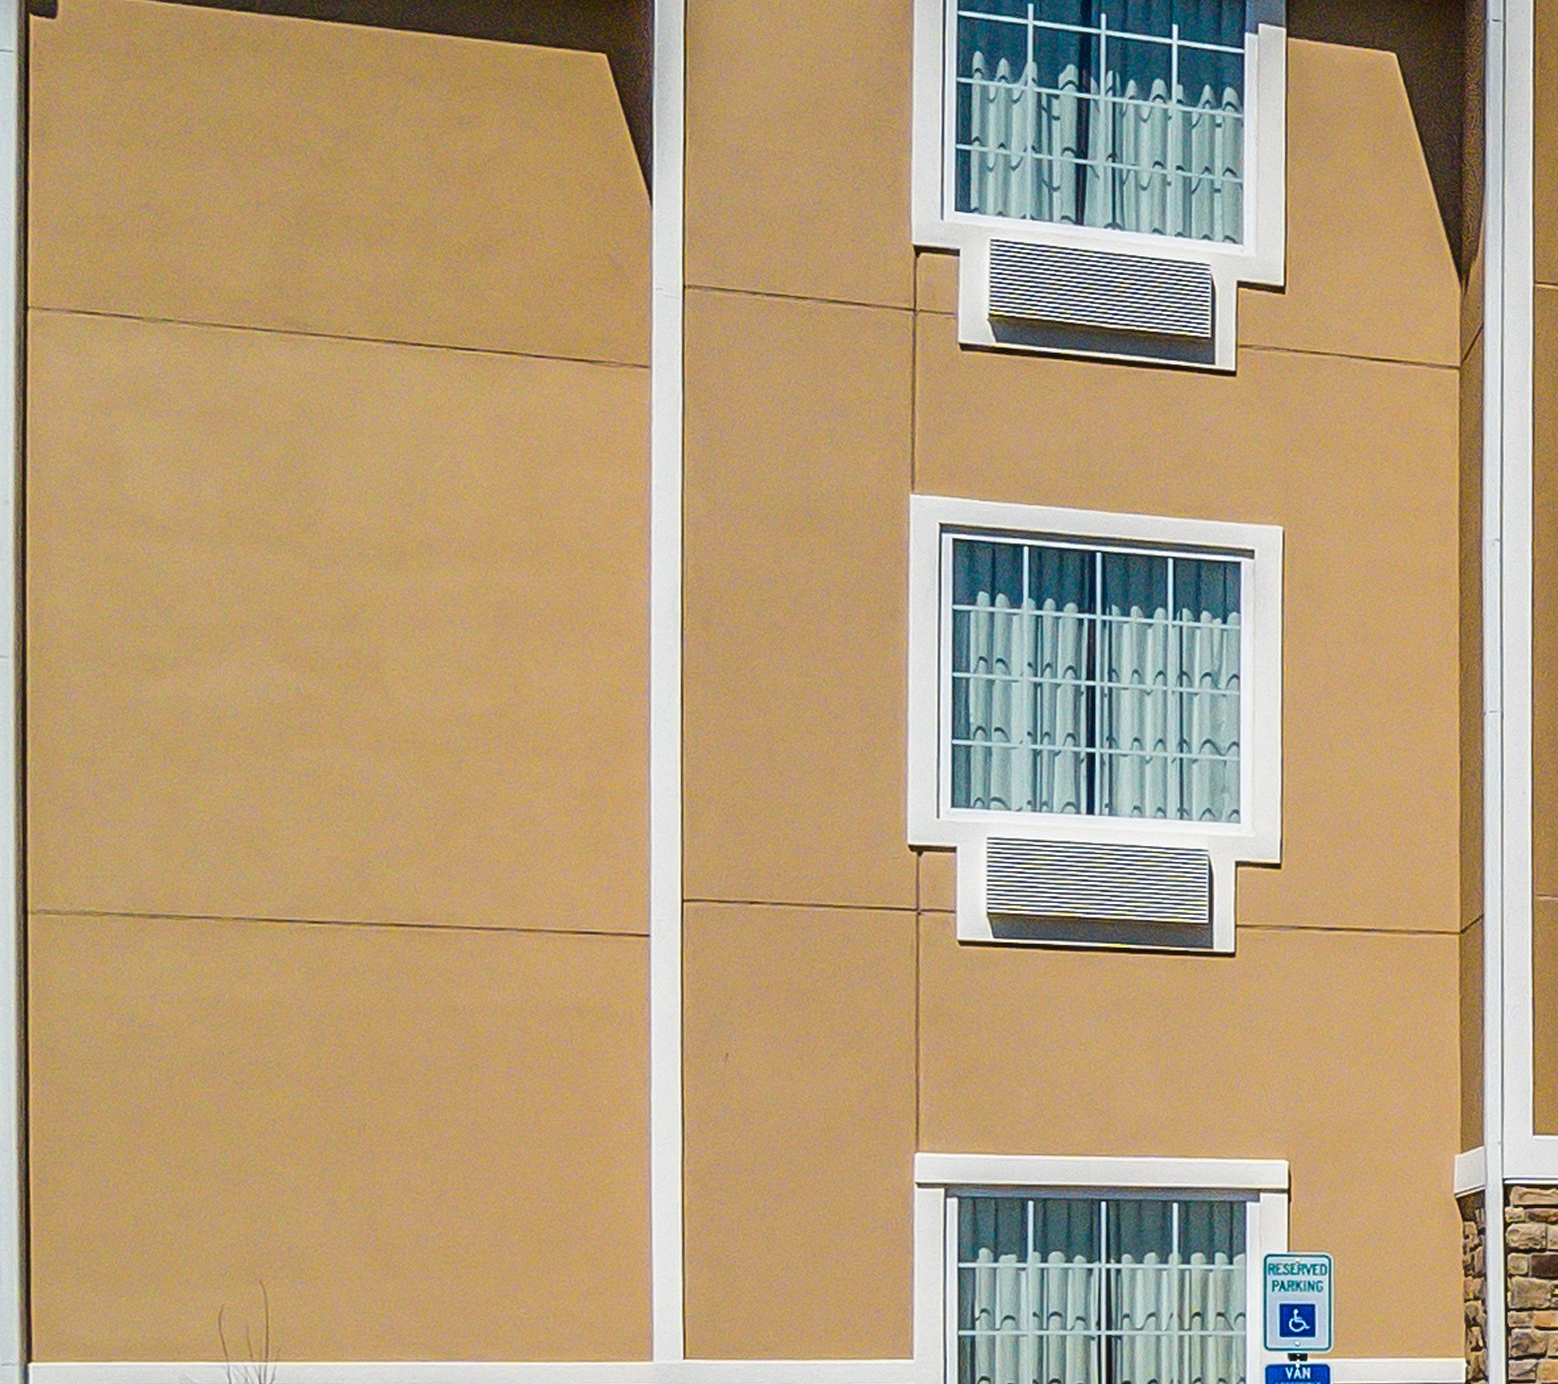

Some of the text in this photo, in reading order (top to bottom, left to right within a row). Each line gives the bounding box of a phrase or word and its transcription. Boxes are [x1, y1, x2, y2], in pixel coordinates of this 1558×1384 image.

[1267, 1262, 1328, 1276] RESERVED
[1271, 1279, 1324, 1293] PARKING
[1285, 1366, 1311, 1380] VAN
